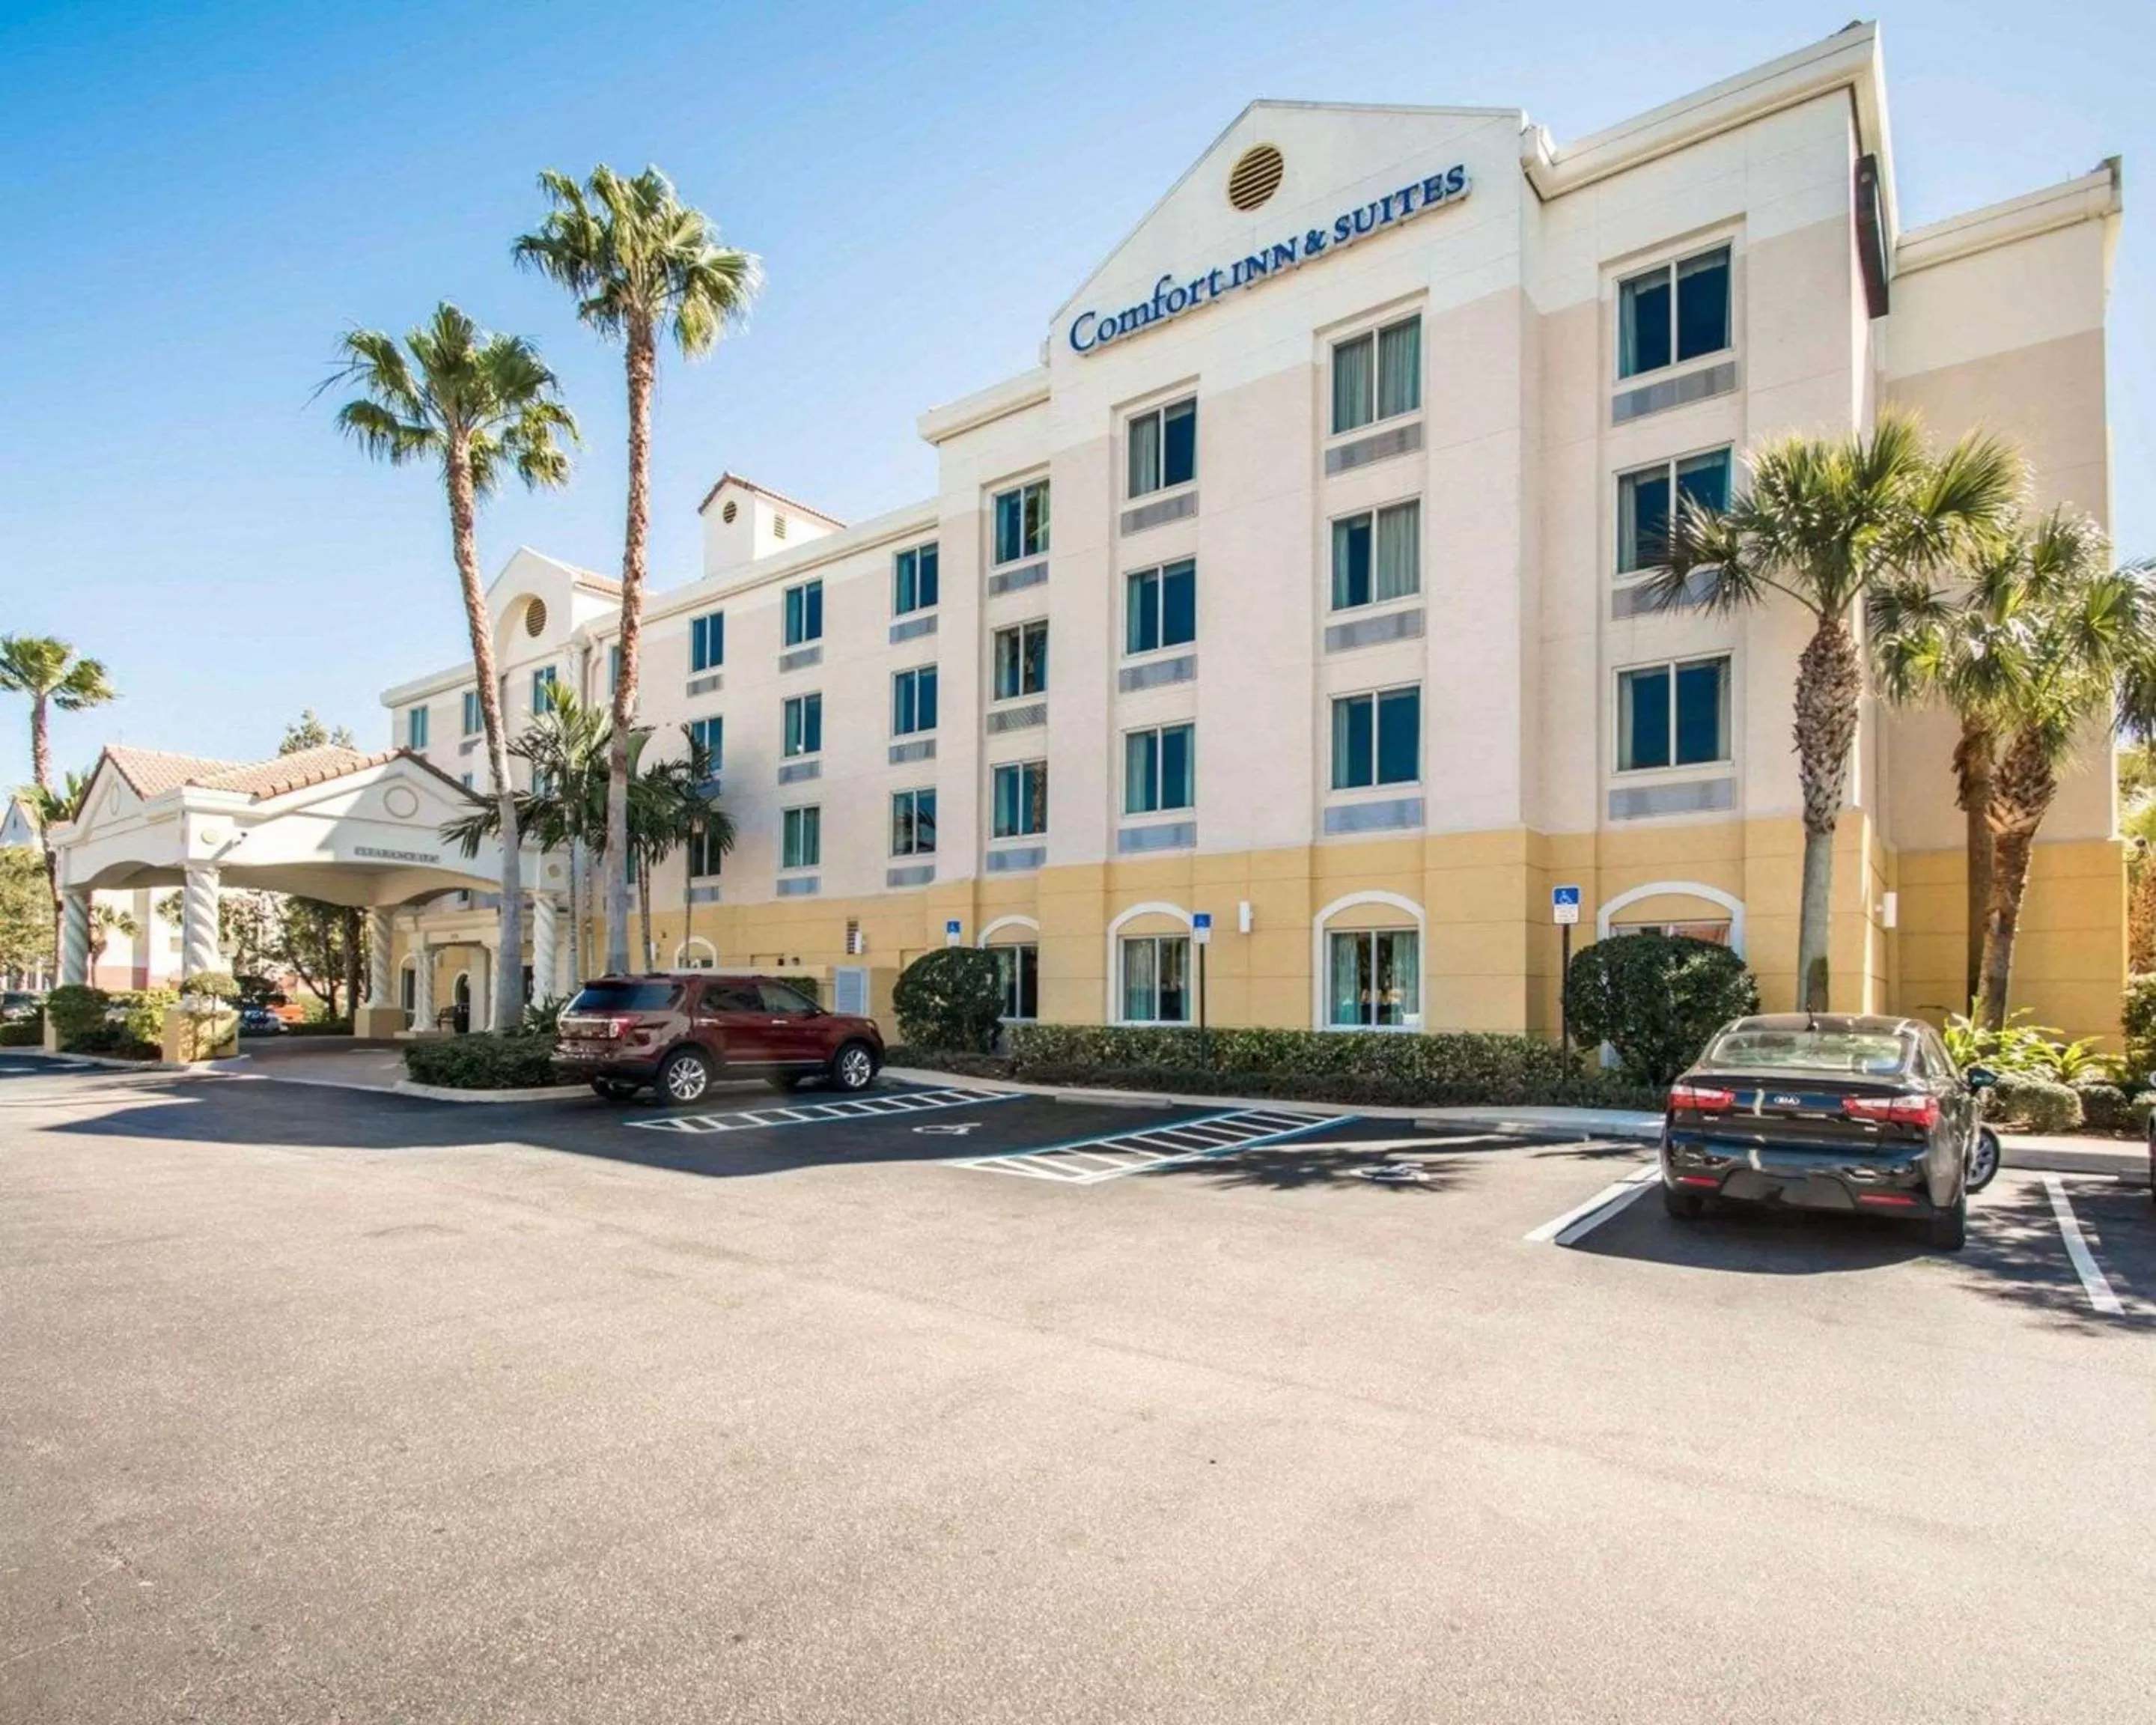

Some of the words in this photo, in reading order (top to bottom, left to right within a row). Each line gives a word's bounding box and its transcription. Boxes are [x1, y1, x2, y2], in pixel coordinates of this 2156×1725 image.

[1069, 274, 1222, 351] Comfort
[1231, 237, 1297, 288] INN
[1305, 229, 1327, 255] &
[1333, 164, 1465, 244] SUITES
